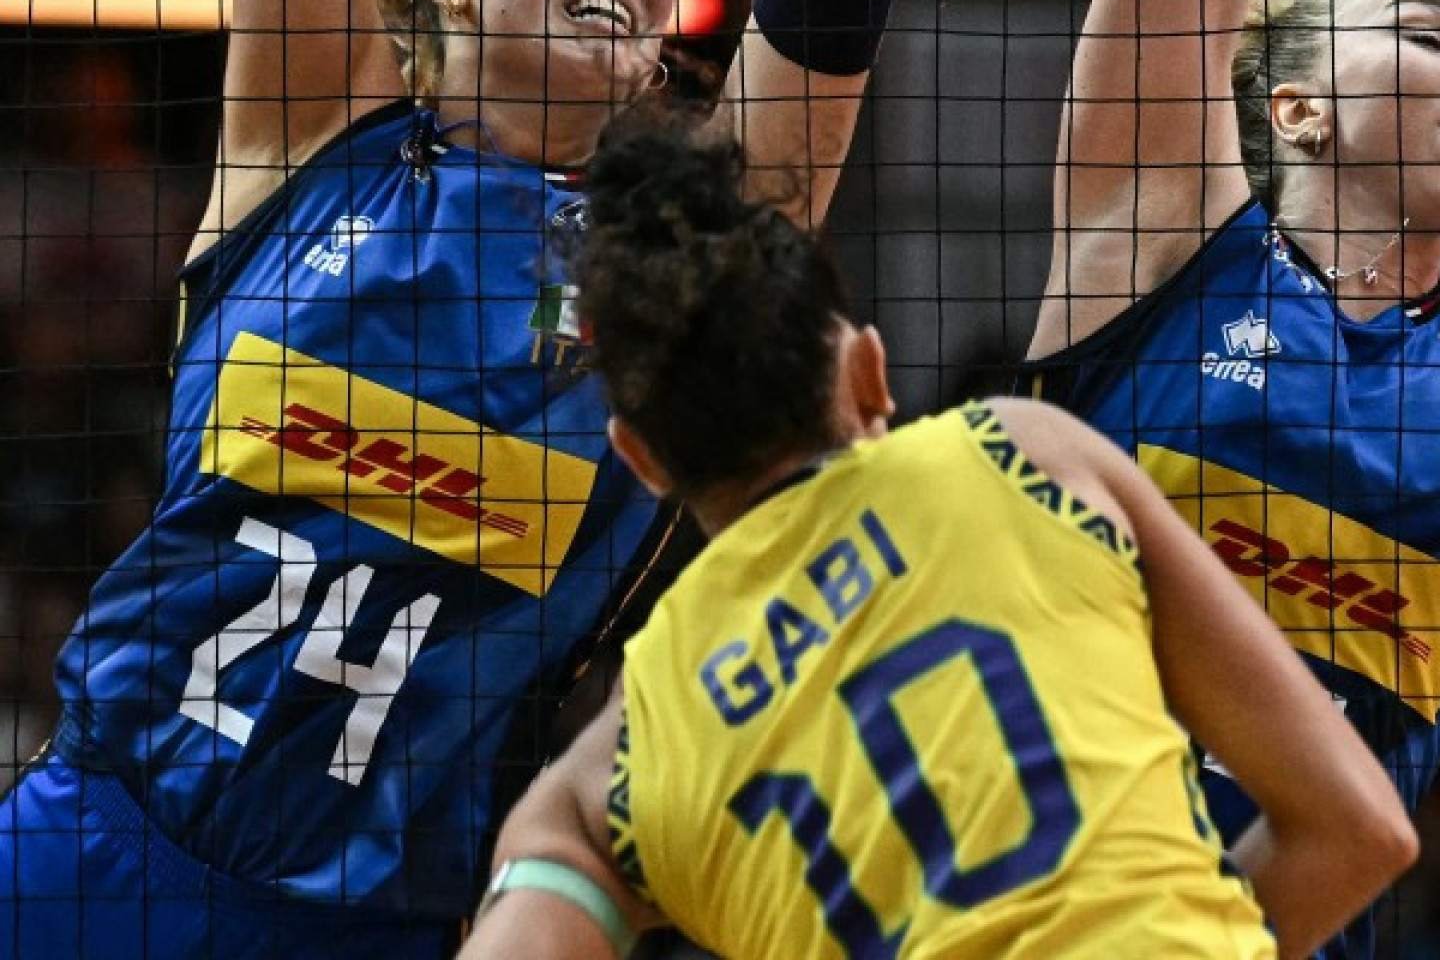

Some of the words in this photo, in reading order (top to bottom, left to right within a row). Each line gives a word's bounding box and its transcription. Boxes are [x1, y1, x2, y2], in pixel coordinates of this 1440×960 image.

[270, 402, 488, 521] DHL
[178, 515, 442, 787] 24
[699, 507, 909, 728] GABI
[1208, 518, 1410, 638] DHL
[726, 615, 1083, 960] 10
